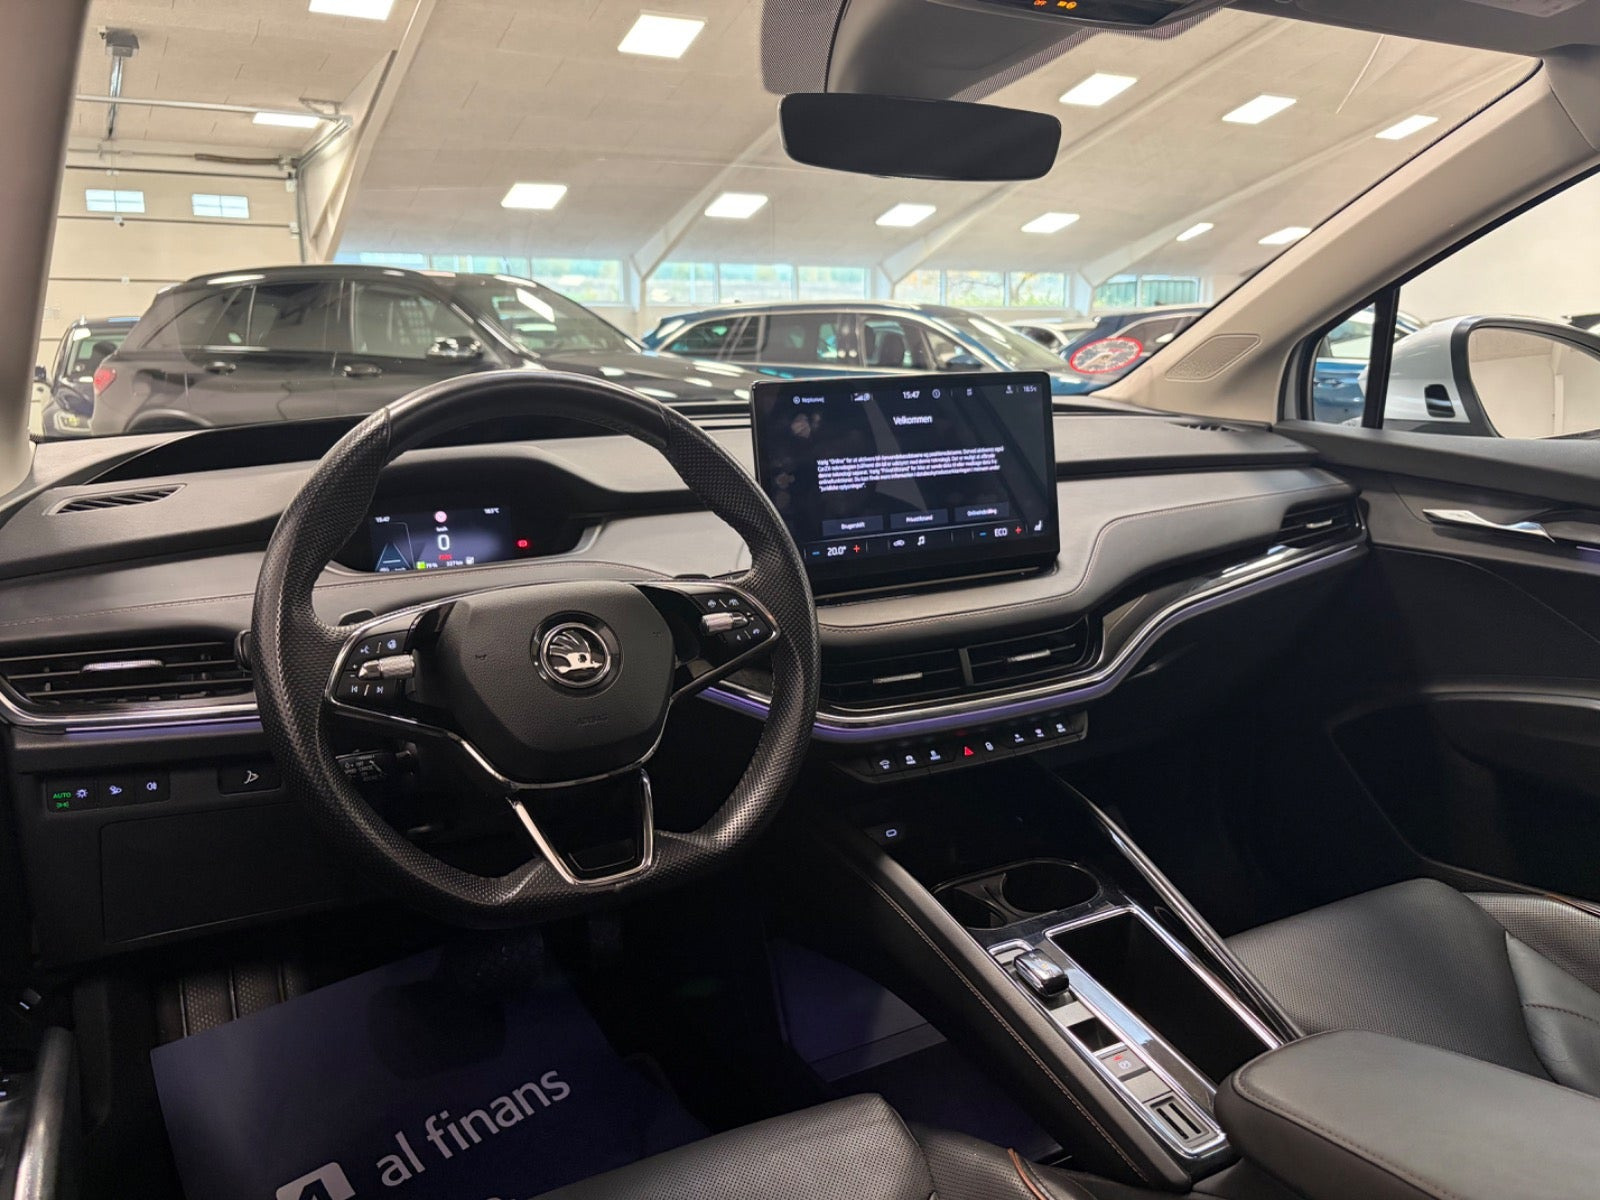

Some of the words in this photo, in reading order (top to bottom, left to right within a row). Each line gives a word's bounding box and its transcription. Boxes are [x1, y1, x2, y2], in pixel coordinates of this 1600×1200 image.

[902, 390, 921, 400] 15:47
[892, 415, 933, 426] Velkommen
[994, 527, 1008, 537] ECO
[52, 791, 73, 800] AUTO
[375, 1130, 426, 1188] al
[424, 1069, 572, 1160] finans
